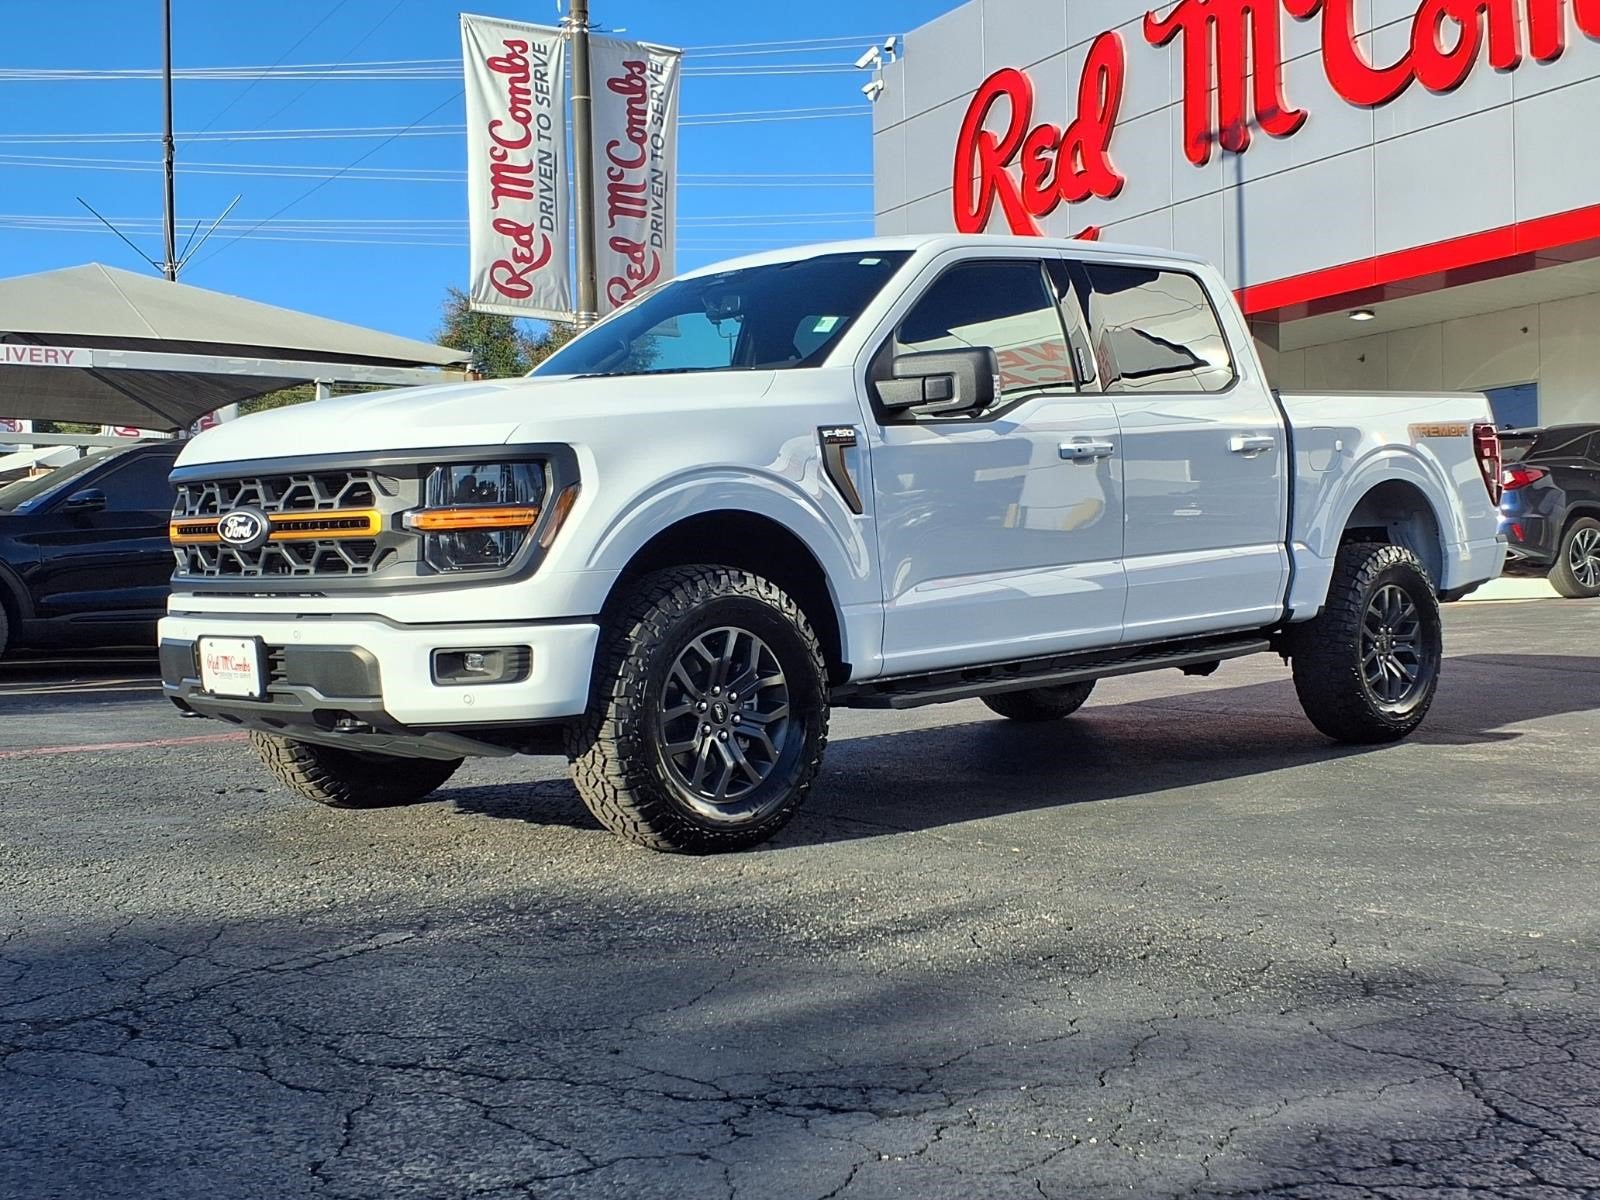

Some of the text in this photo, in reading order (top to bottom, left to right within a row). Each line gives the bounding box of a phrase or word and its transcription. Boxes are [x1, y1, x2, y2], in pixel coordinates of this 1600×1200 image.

[486, 39, 552, 299] Red McCombs
[532, 41, 554, 233] DRIVEN TO SERVE
[606, 60, 661, 309] Red McCombs
[648, 62, 665, 249] DRIVEN TO SERVE
[952, 31, 1126, 242] Red
[224, 515, 253, 538] Ford
[822, 428, 856, 438] F-150
